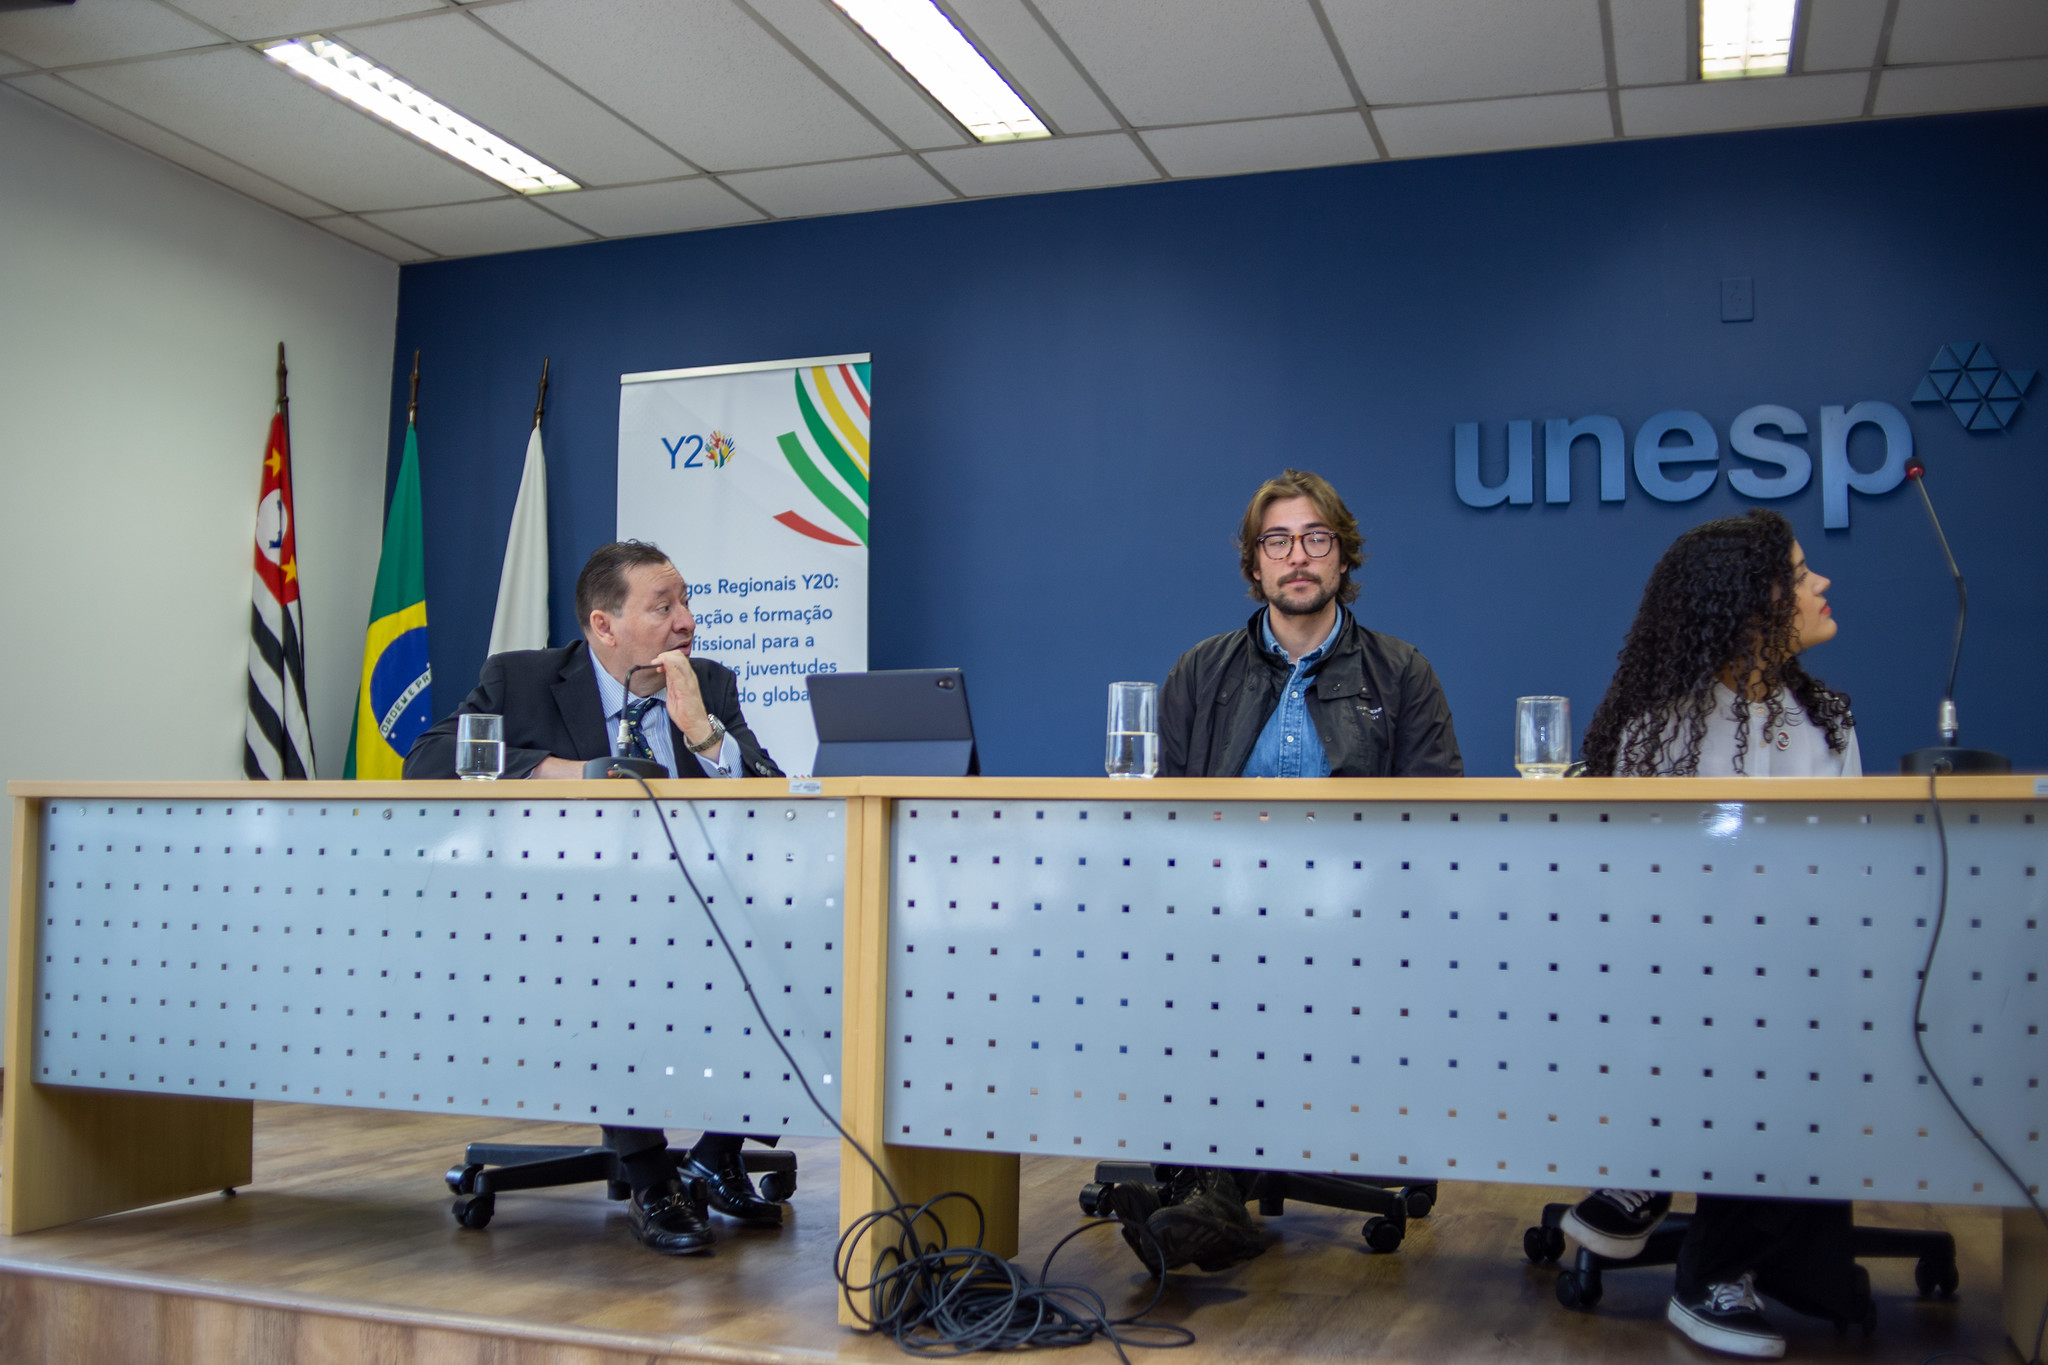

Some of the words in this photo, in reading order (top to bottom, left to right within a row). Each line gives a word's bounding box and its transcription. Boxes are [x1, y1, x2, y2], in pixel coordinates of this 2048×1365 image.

[1454, 401, 1914, 529] unesp
[718, 576, 796, 597] Regionais
[802, 573, 839, 590] Y20:
[692, 608, 733, 629] ação
[739, 611, 748, 623] e
[754, 605, 833, 625] formação
[762, 636, 799, 653] para
[805, 635, 814, 648] a
[744, 658, 837, 681] juventudes
[381, 696, 408, 733] ORDEM
